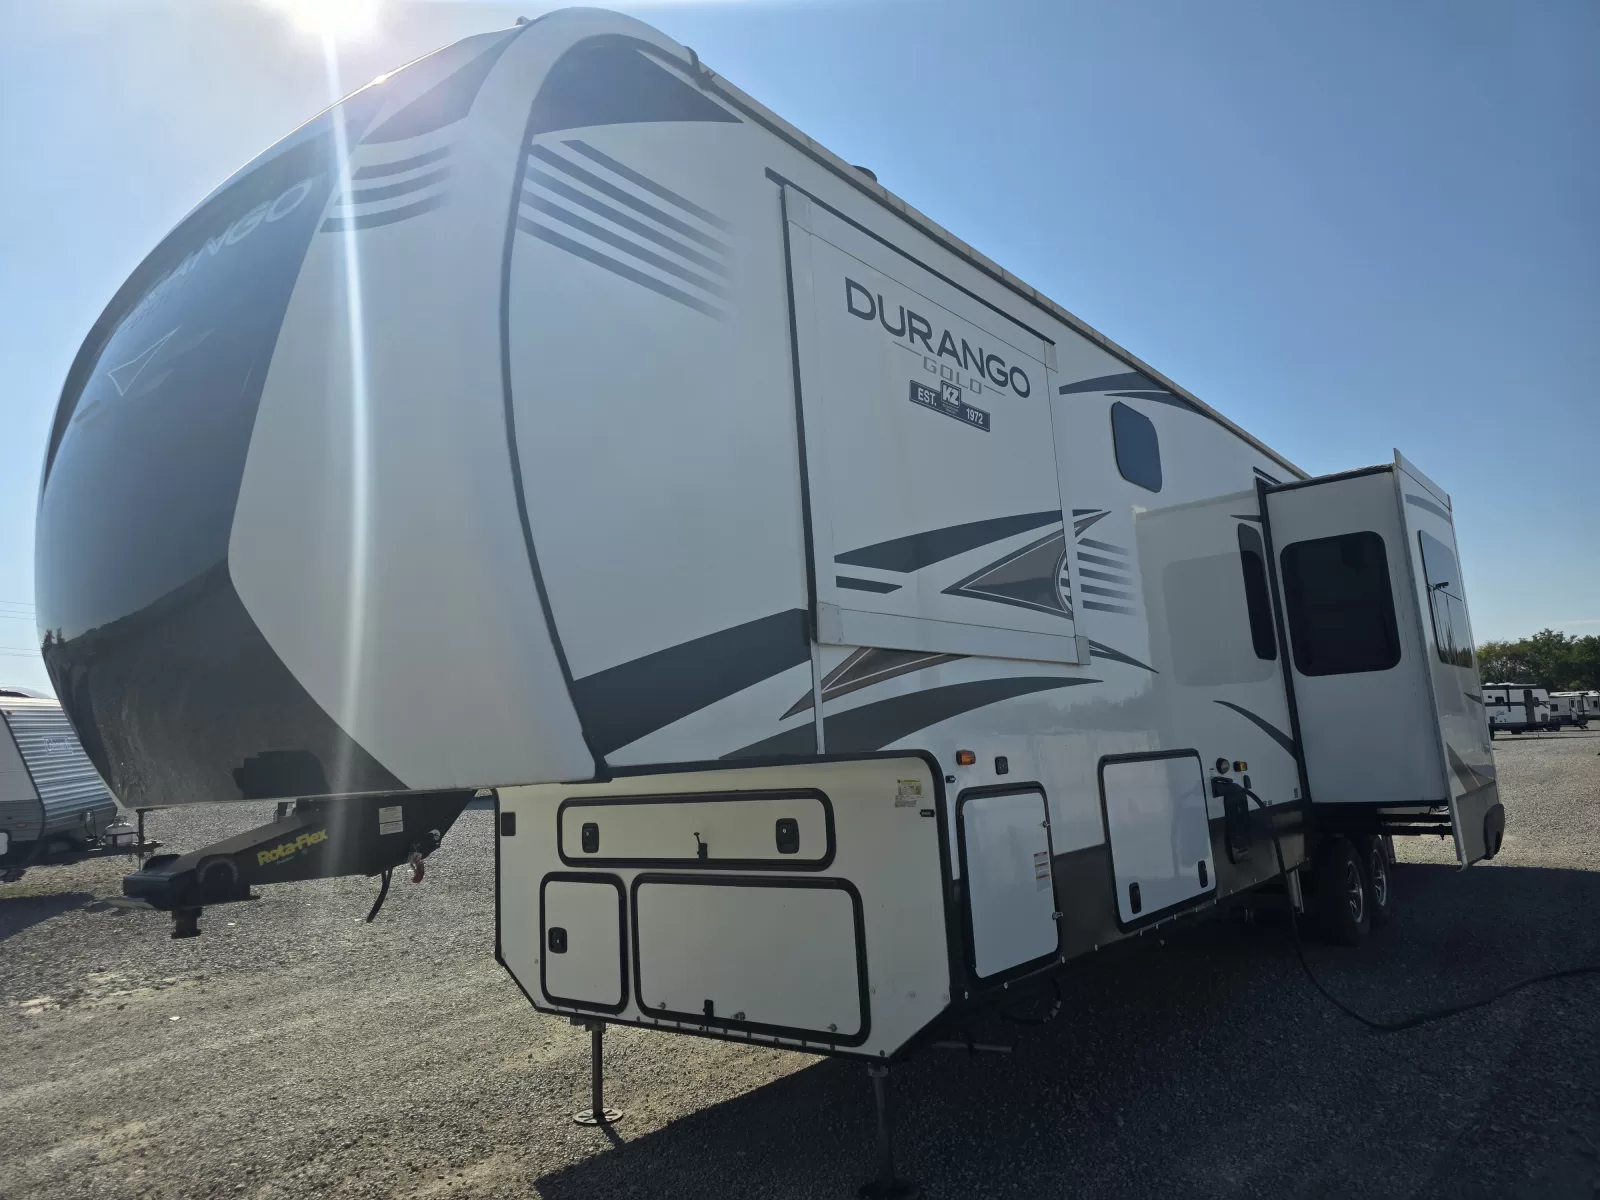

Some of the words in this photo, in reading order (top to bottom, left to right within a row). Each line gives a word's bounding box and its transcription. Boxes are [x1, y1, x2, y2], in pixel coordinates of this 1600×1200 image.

[845, 276, 1031, 399] DURANGO
[923, 355, 982, 395] GOLD
[917, 387, 937, 407] EST.
[966, 407, 984, 425] 1972
